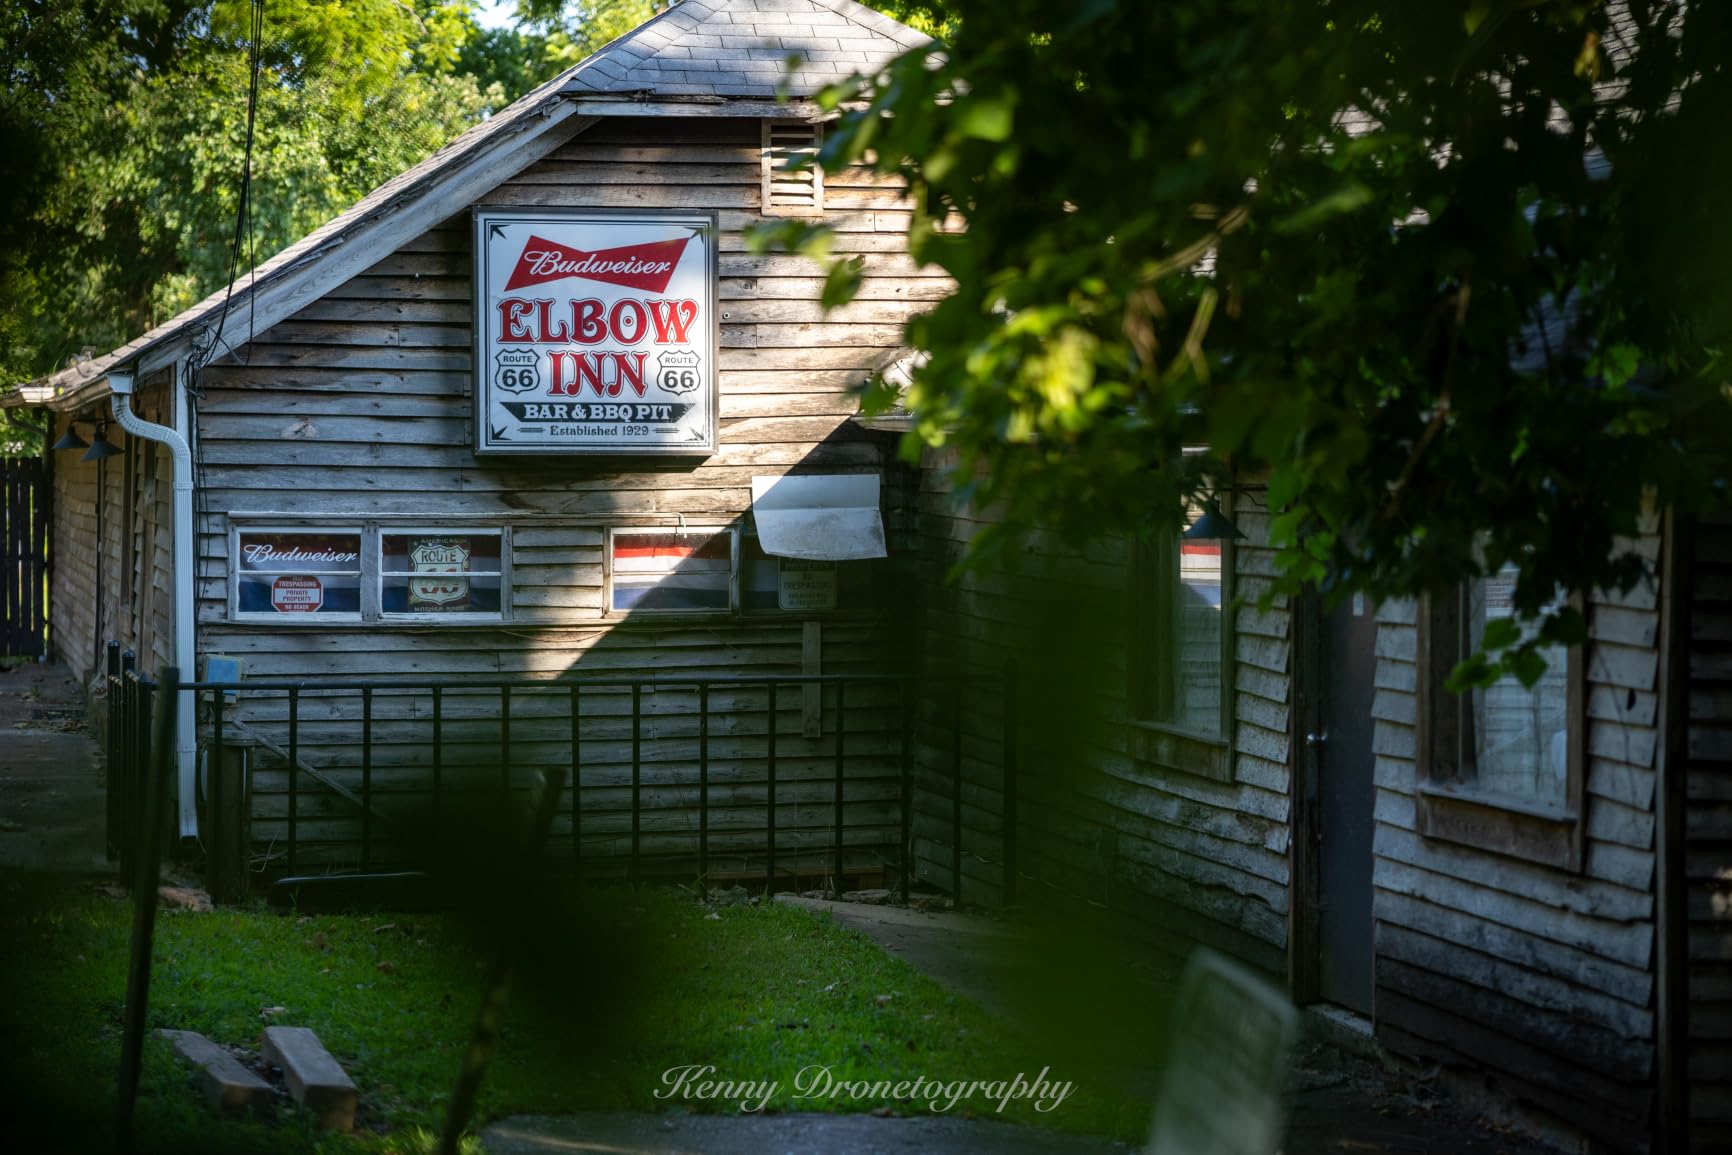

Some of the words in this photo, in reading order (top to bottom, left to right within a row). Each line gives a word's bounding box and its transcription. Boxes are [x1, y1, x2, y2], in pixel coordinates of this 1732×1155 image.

[524, 251, 671, 276] Budweiser
[497, 298, 699, 345] ELBOW
[503, 355, 533, 363] ROUTE
[664, 356, 694, 364] ROUTE
[502, 369, 534, 388] 66
[547, 350, 650, 398] INN
[663, 370, 695, 388] 66
[524, 405, 568, 420] BAR
[571, 405, 587, 420] &
[588, 404, 634, 422] BBQ
[636, 405, 672, 420] PIT
[550, 425, 618, 436] Established
[622, 426, 649, 436] 1929
[244, 544, 357, 563] Budweiser
[421, 550, 457, 562] ROUTE
